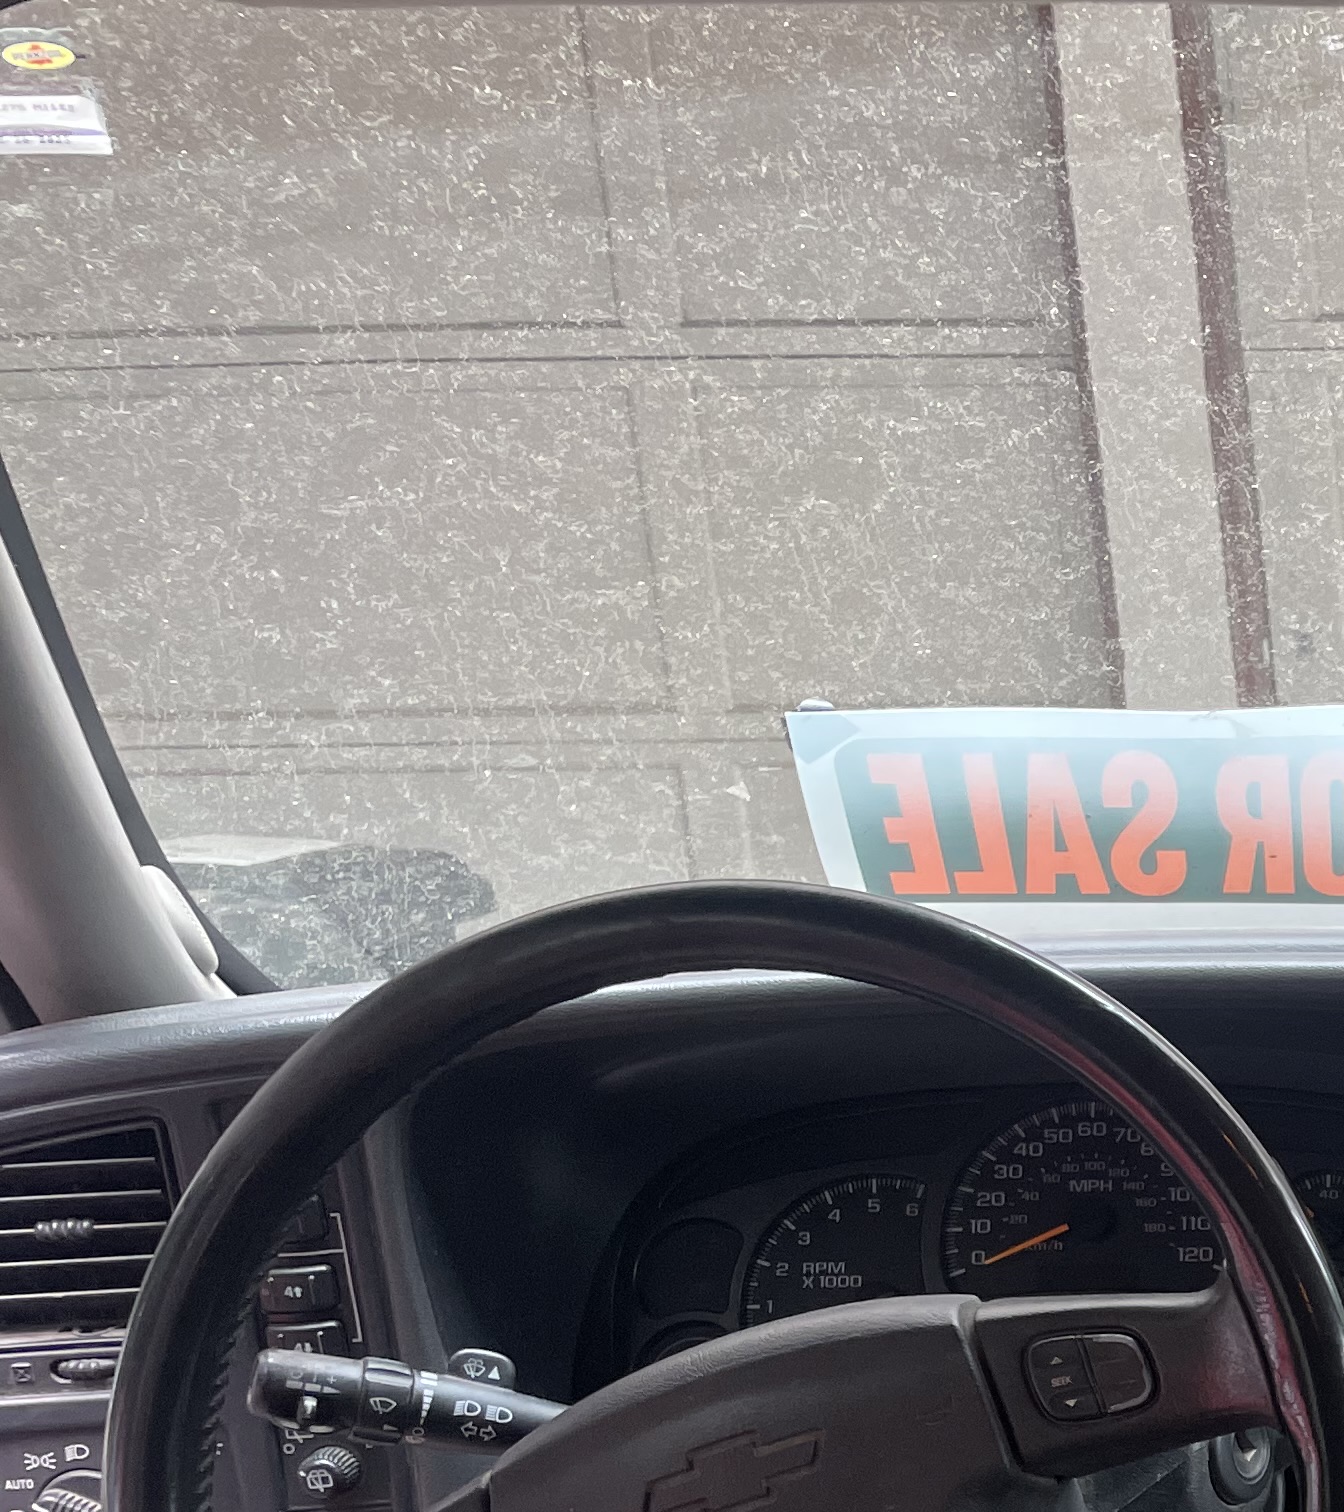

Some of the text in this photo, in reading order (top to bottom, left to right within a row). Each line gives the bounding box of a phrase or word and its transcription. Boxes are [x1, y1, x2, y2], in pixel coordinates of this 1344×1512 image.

[1043, 1129, 1073, 1144] 50
[1078, 1123, 1107, 1137] 60
[1113, 1128, 1141, 1143] 70
[1013, 1143, 1044, 1157] 40
[994, 1164, 1023, 1179] 30
[1069, 1180, 1113, 1193] MPH
[976, 1192, 1006, 1207] 20
[1021, 1191, 1040, 1201] 40
[1319, 1189, 1339, 1200] 40
[867, 1199, 881, 1213] 5
[906, 1203, 919, 1217] 6
[828, 1209, 840, 1223] 4
[970, 1219, 991, 1234] 10
[1181, 1216, 1211, 1232] 110
[798, 1231, 811, 1246] 3
[971, 1250, 985, 1265] 0
[1177, 1247, 1213, 1262] 120
[775, 1262, 789, 1277] 2
[802, 1262, 846, 1275] RPM
[802, 1276, 863, 1289] X 1000
[766, 1300, 773, 1314] 1
[4, 1478, 34, 1491] AUTO
